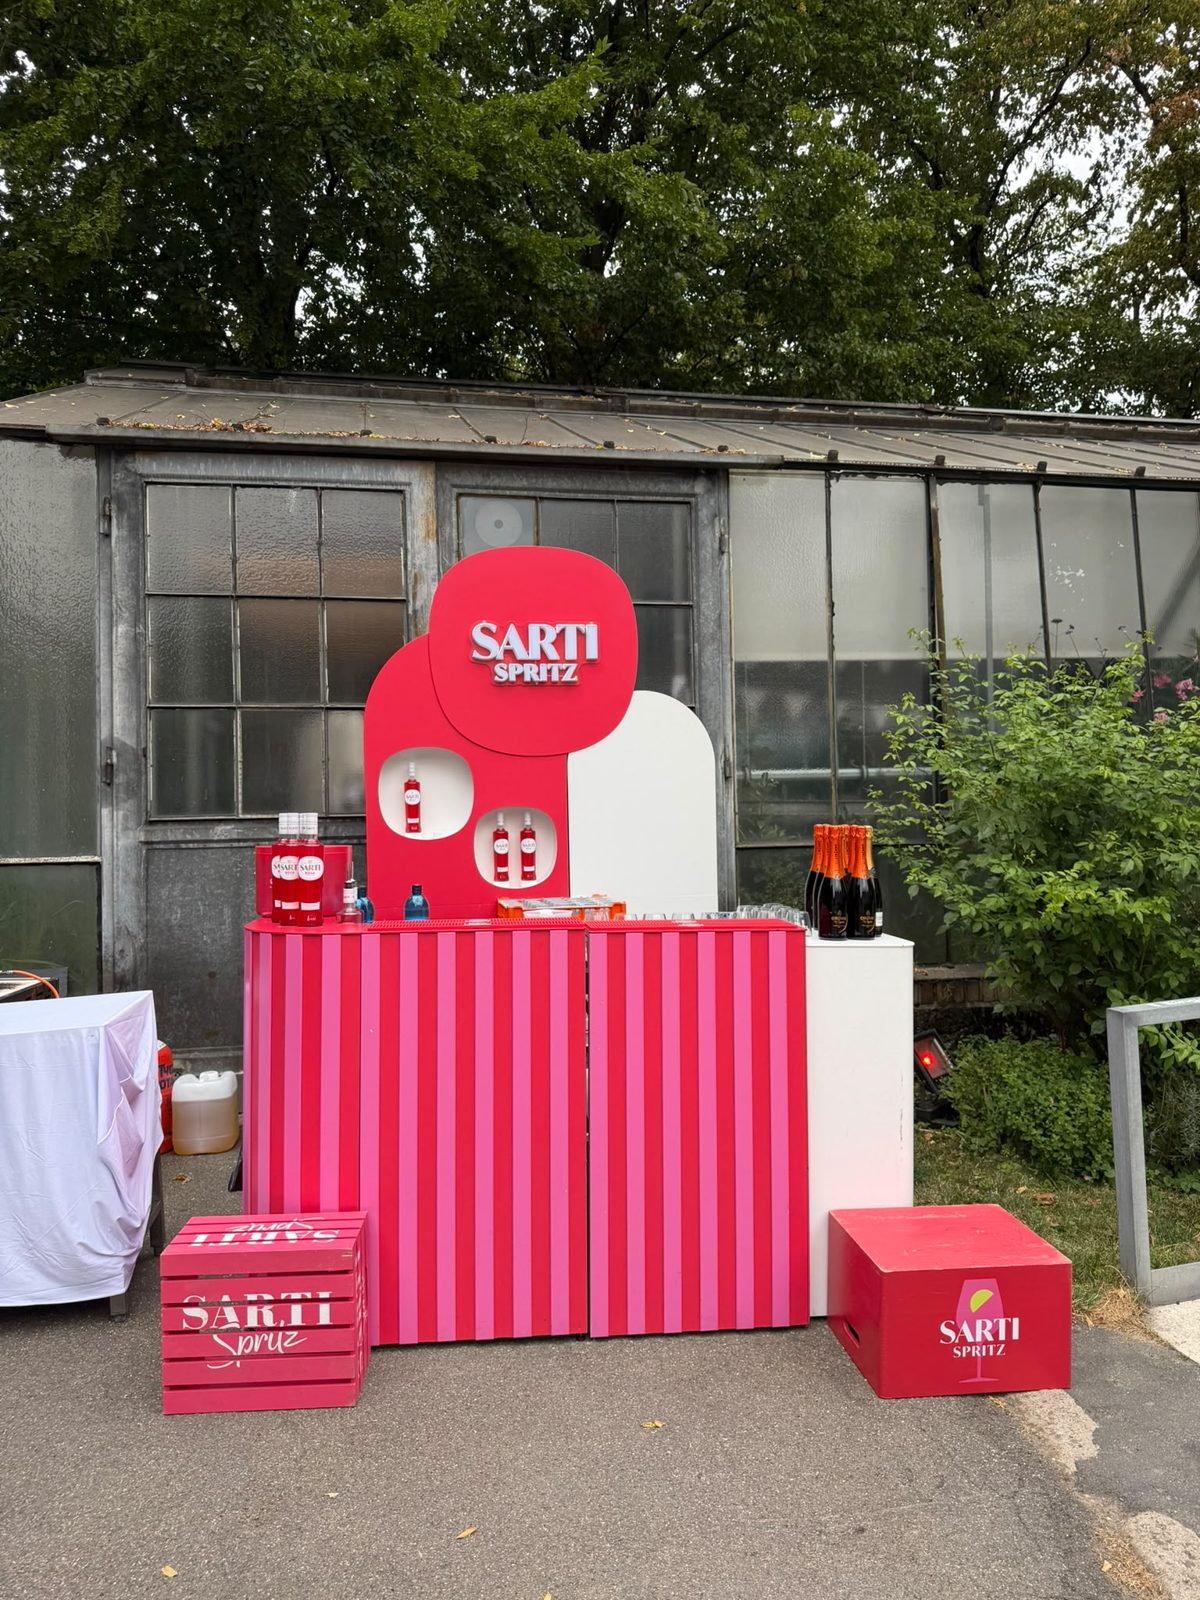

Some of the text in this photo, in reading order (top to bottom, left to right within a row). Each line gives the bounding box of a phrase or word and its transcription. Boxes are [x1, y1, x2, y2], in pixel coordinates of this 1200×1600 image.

[471, 621, 598, 661] SARTI
[493, 662, 579, 682] SPRITZ
[189, 1230, 341, 1247] SARTI
[182, 1292, 333, 1330] SARTI
[940, 1318, 1019, 1344] SARTI
[952, 1344, 1006, 1358] SPRITZ
